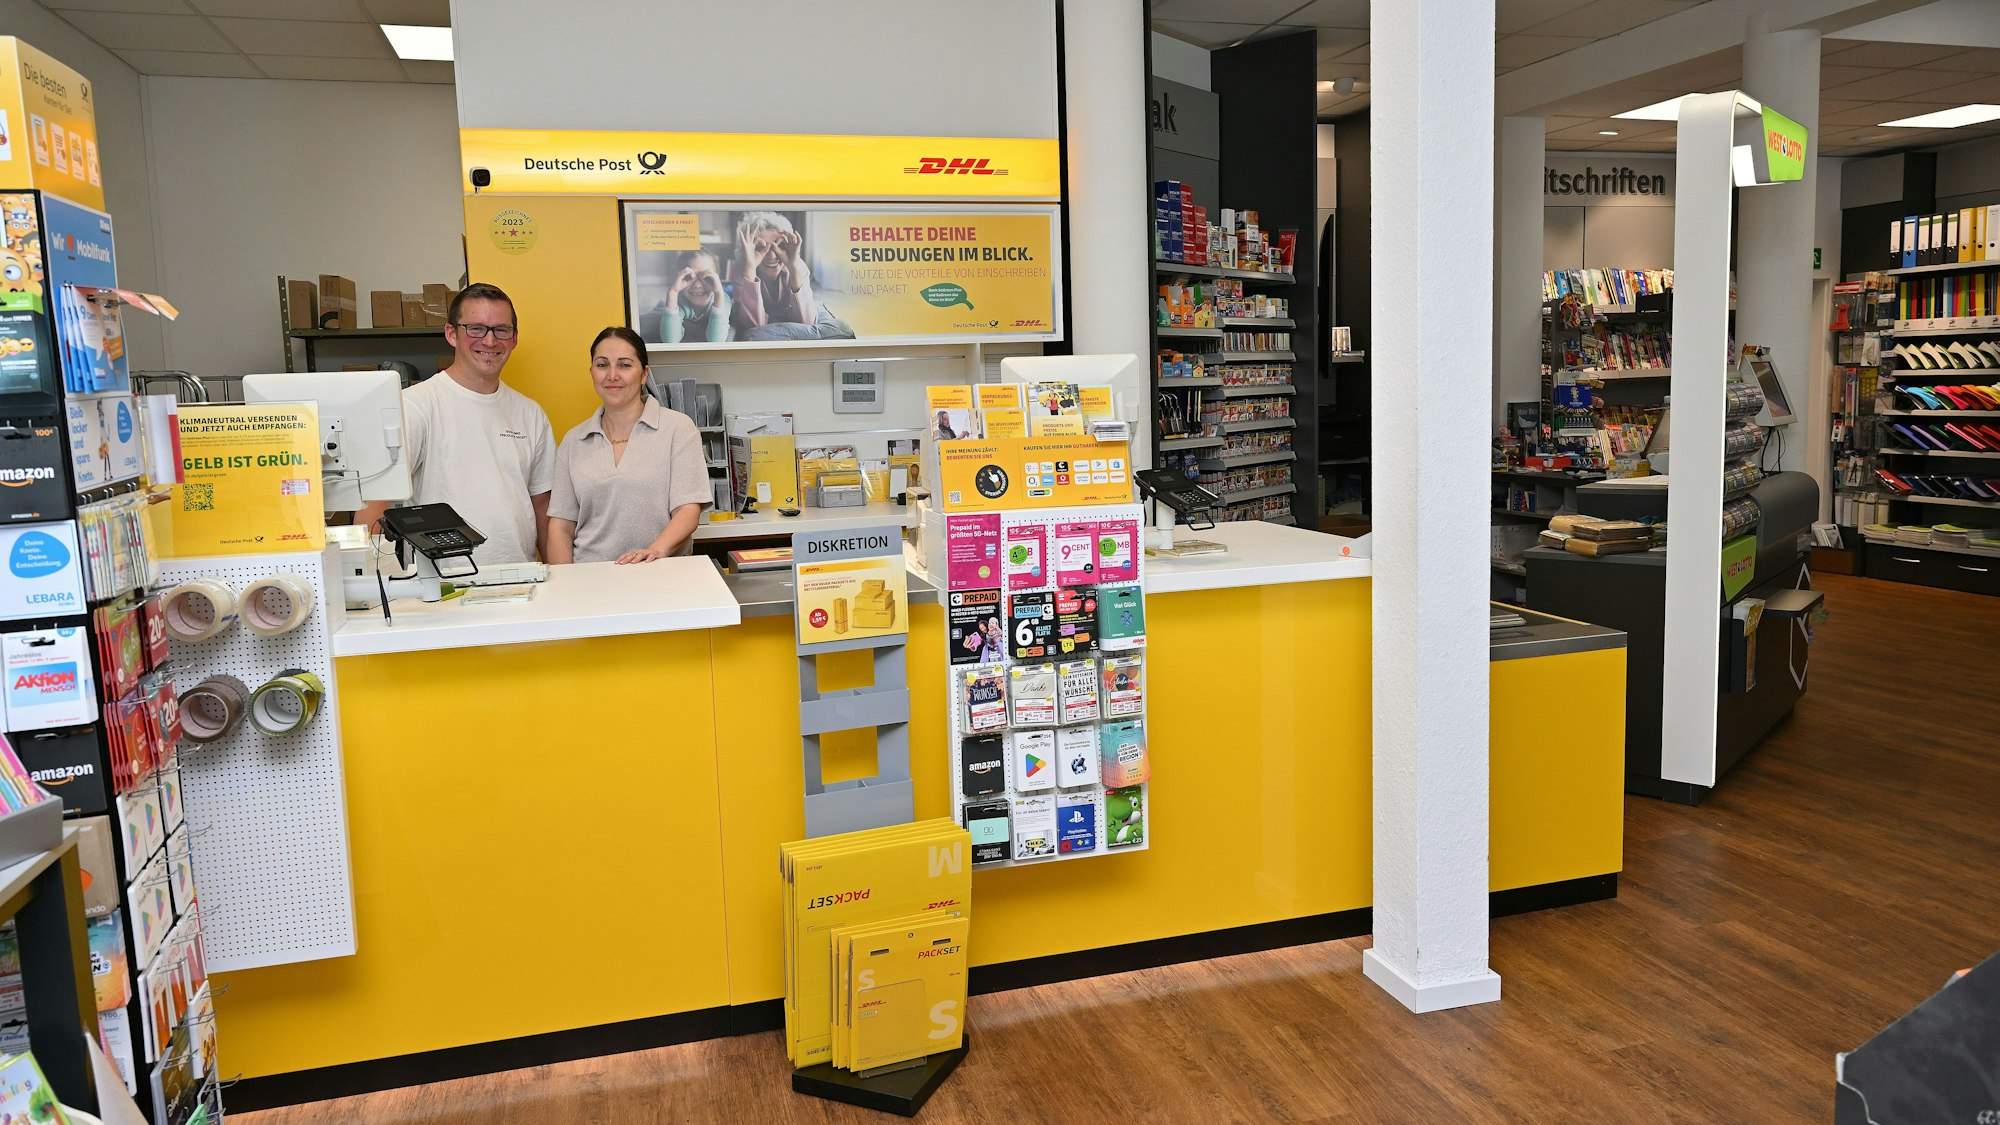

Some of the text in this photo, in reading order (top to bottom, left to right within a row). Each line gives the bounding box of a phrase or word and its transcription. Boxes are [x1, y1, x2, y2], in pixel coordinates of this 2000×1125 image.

[24, 62, 67, 99] Die besten
[1152, 92, 1178, 135] ak
[524, 157, 632, 171] Deutsche Post
[918, 157, 995, 175] DHL
[1543, 166, 1666, 195] itschriften
[502, 218, 524, 226] 2023
[850, 226, 977, 242] BEHALTE DEINE
[52, 231, 111, 264] Wir Mobilfunk
[850, 246, 1034, 262] SENDUNGEN IM BLICK.
[850, 267, 1047, 279] NUTZE DIE VORTEILE VON EINSCHREIBEN
[851, 284, 909, 295] UND PAKET.
[1015, 319, 1042, 327] DHL
[70, 406, 84, 419] Bleib
[180, 414, 298, 426] KLIMANEUTRAL VERSENDEN
[71, 422, 88, 434] locker
[180, 421, 307, 433] UND JETZT AUCH EMPFANGEN:
[74, 438, 84, 450] und
[76, 453, 91, 466] spare
[182, 450, 308, 471] GELB IST GRÜN.
[0, 466, 55, 479] mazon
[78, 470, 95, 483] Knete.
[950, 524, 972, 533] Prepaid
[281, 533, 308, 542] DHL
[950, 531, 973, 540] größten
[808, 535, 888, 554] DISKRETION
[27, 553, 48, 561] Deine
[1061, 543, 1091, 560] 9 CENT
[16, 560, 63, 569] Entscheidung.
[25, 591, 75, 605] LEBARA
[964, 592, 997, 603] PREPAID
[1015, 605, 1041, 614] PREPAID
[1015, 618, 1034, 647] 6
[9, 651, 42, 660] Jahreslos
[1020, 683, 1047, 694] Danke
[1063, 677, 1094, 688] FÜR ALLE
[40, 683, 77, 695] MENSCH
[1020, 741, 1052, 751] Google Play
[1119, 753, 1139, 763] REGION
[969, 759, 1001, 771] amazon
[31, 762, 94, 782] amazon
[807, 888, 871, 910] PACKSET
[918, 945, 961, 960] PACKSET
[927, 999, 959, 1040] S
